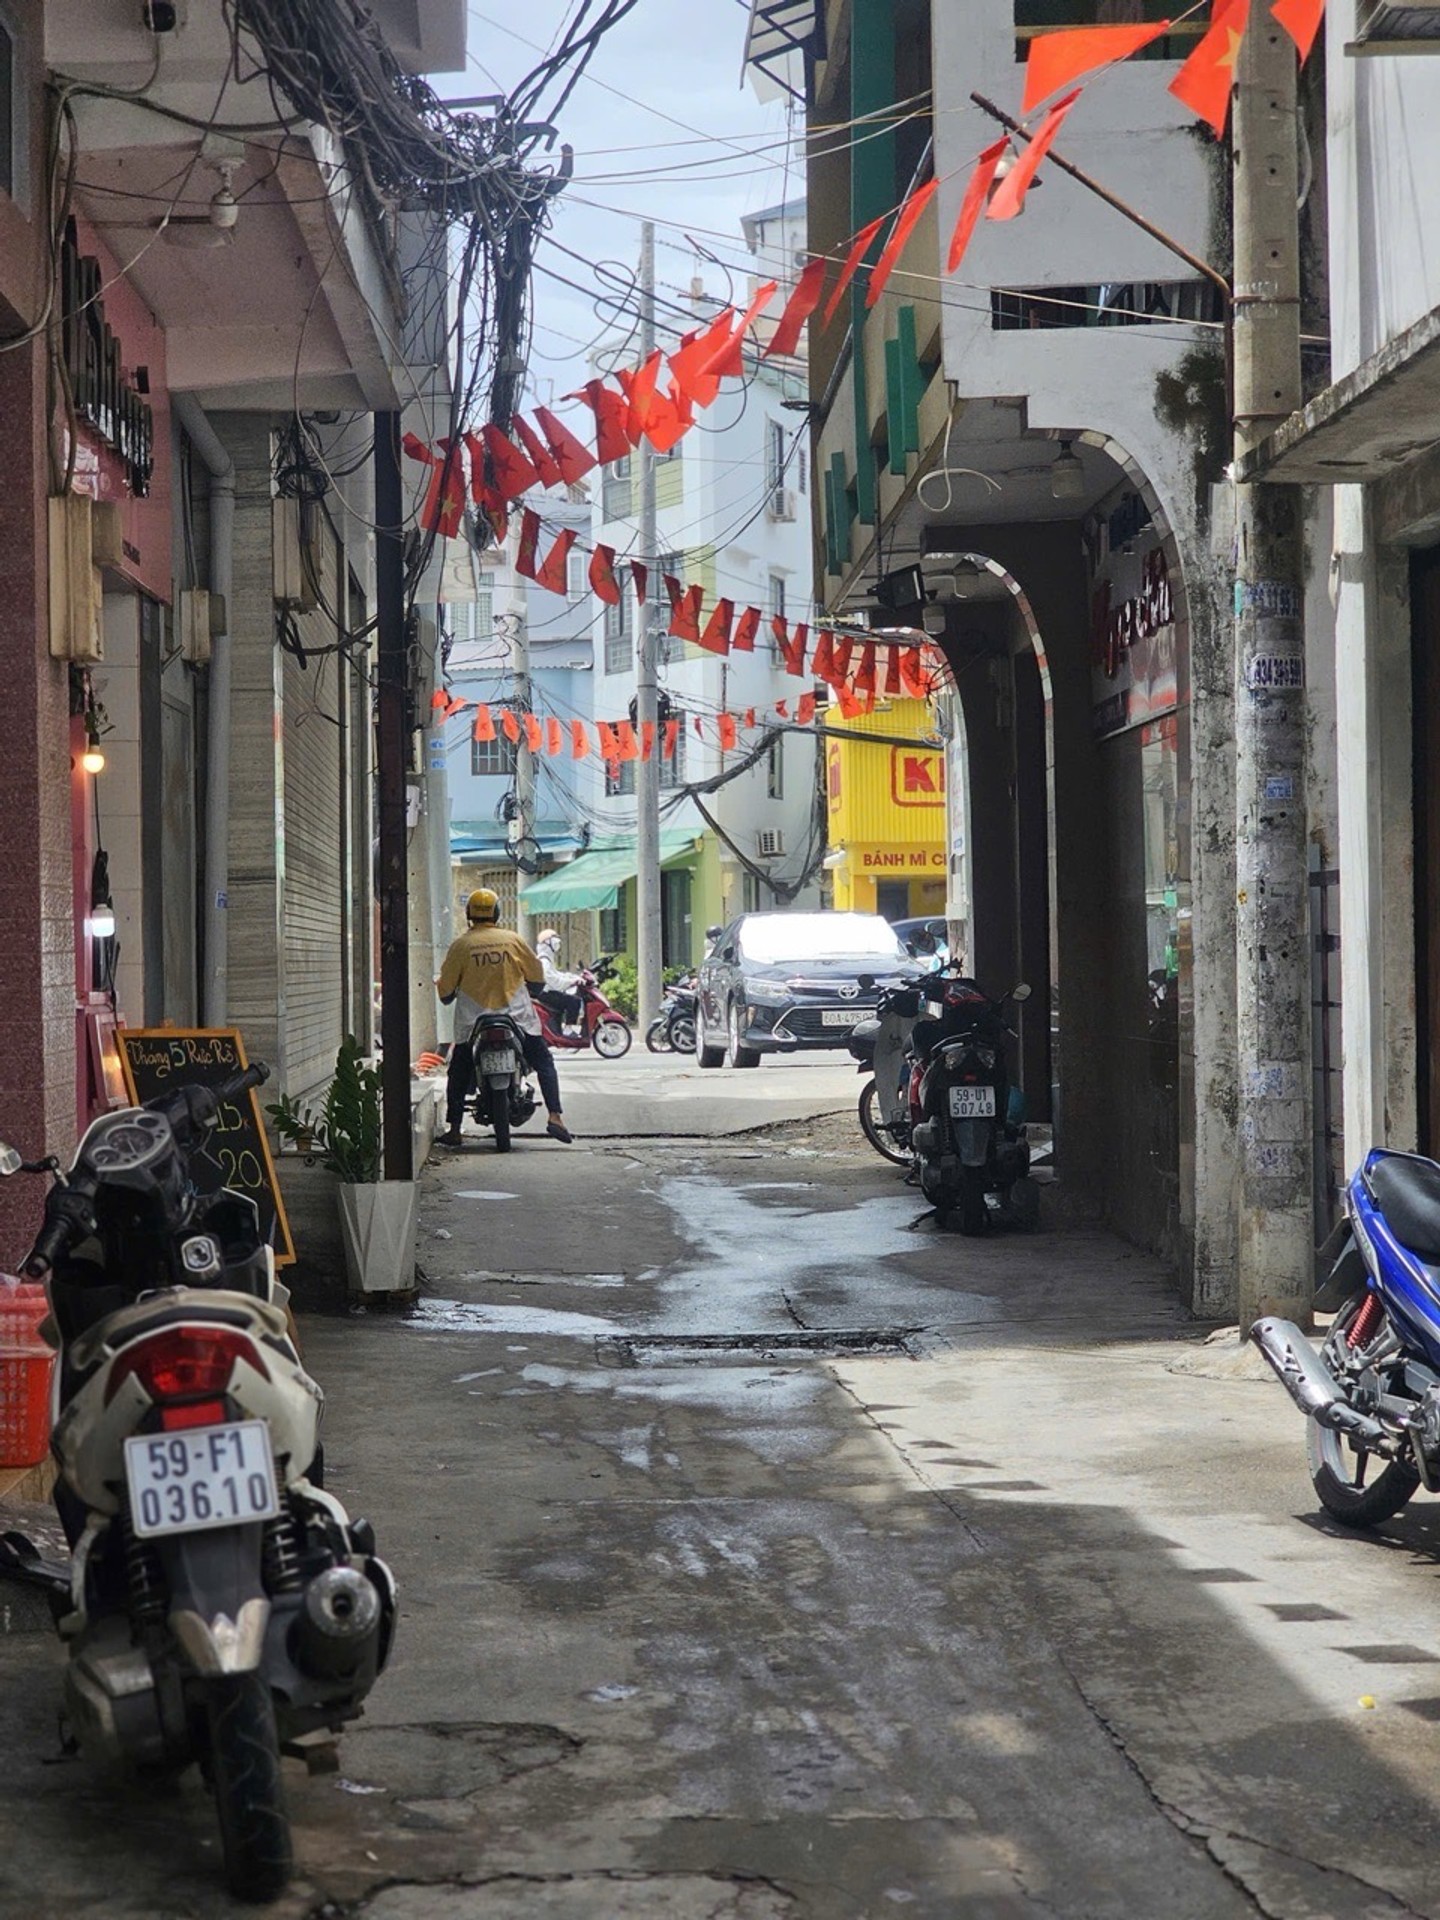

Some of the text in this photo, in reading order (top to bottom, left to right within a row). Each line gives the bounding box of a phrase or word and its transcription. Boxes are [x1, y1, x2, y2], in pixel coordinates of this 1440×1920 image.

[863, 850, 904, 866] BÁNH
[909, 850, 926, 866] MÌ
[126, 1040, 172, 1078] Tháng
[169, 1042, 186, 1067] 5
[956, 1088, 987, 1102] 59-U1
[952, 1102, 993, 1116] 507.48
[148, 1431, 245, 1481] 59-F1
[141, 1472, 269, 1527] 036.10
